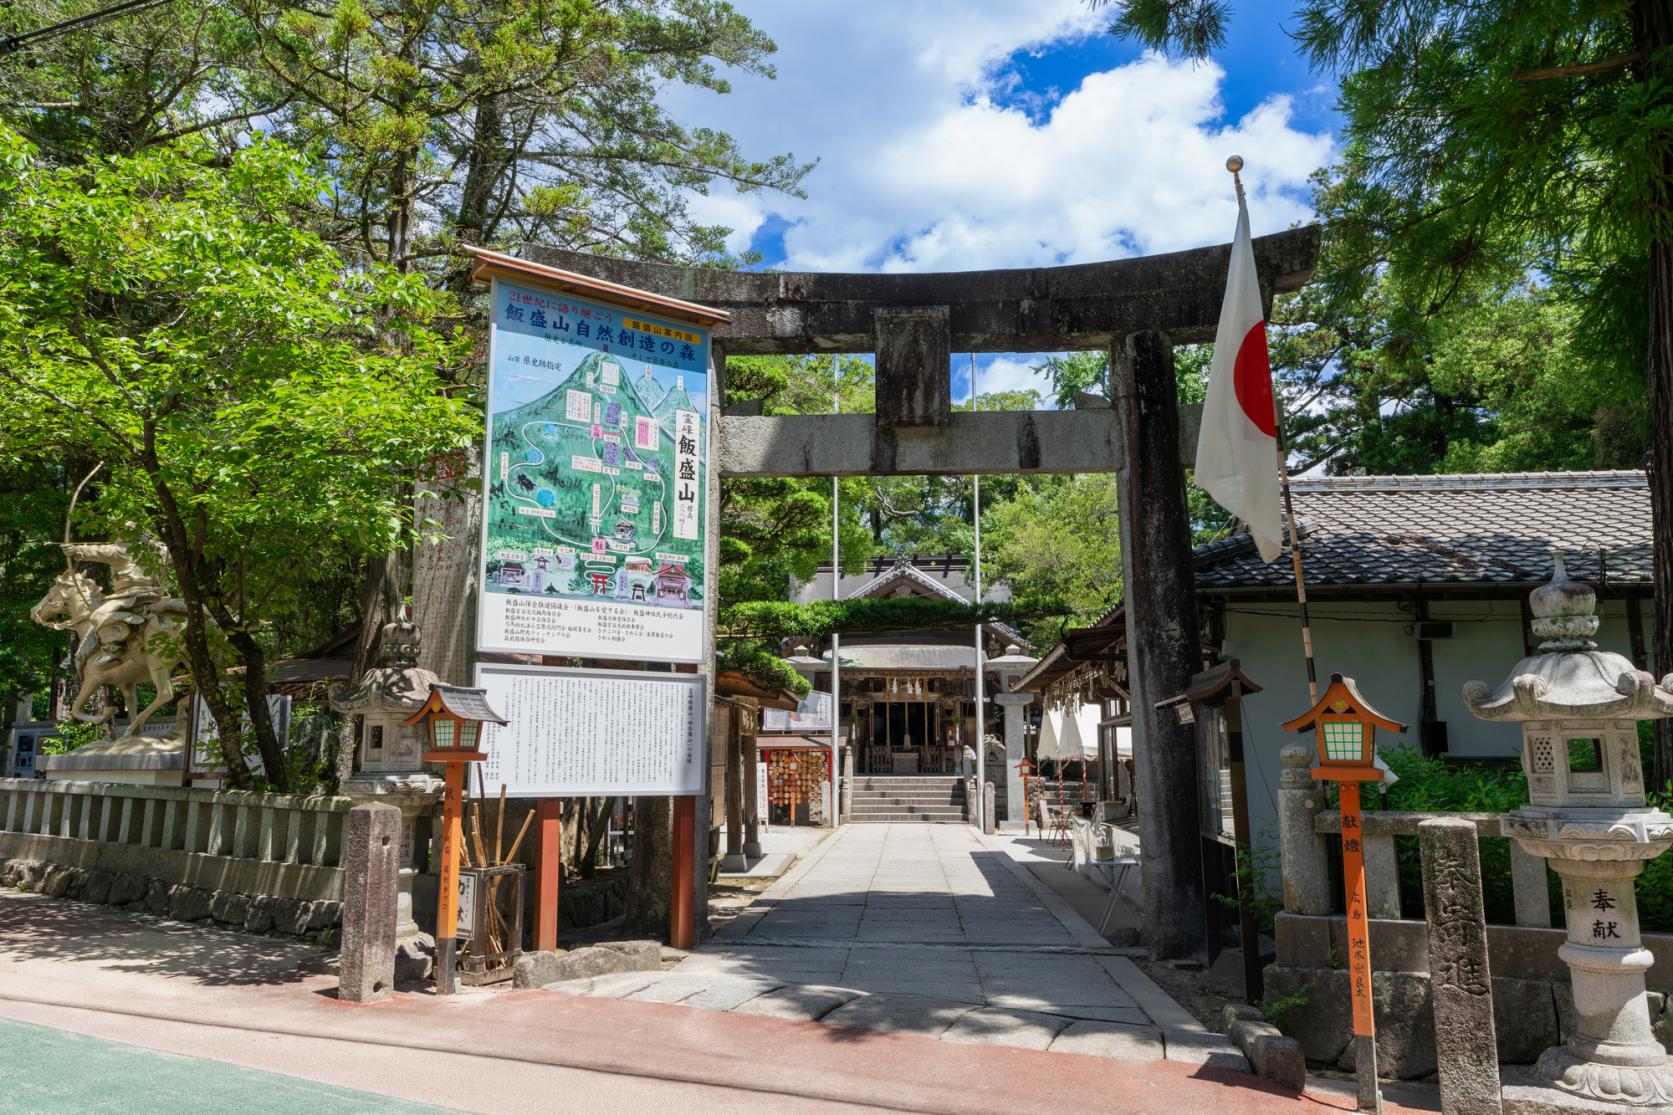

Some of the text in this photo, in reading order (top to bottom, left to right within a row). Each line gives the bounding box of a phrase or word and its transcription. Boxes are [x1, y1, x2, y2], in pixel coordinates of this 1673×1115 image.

[504, 302, 697, 362] 飯盛山自然創造の森
[1342, 814, 1360, 853] 献燈
[1350, 891, 1363, 920] 広島
[1590, 888, 1621, 939] 奉献
